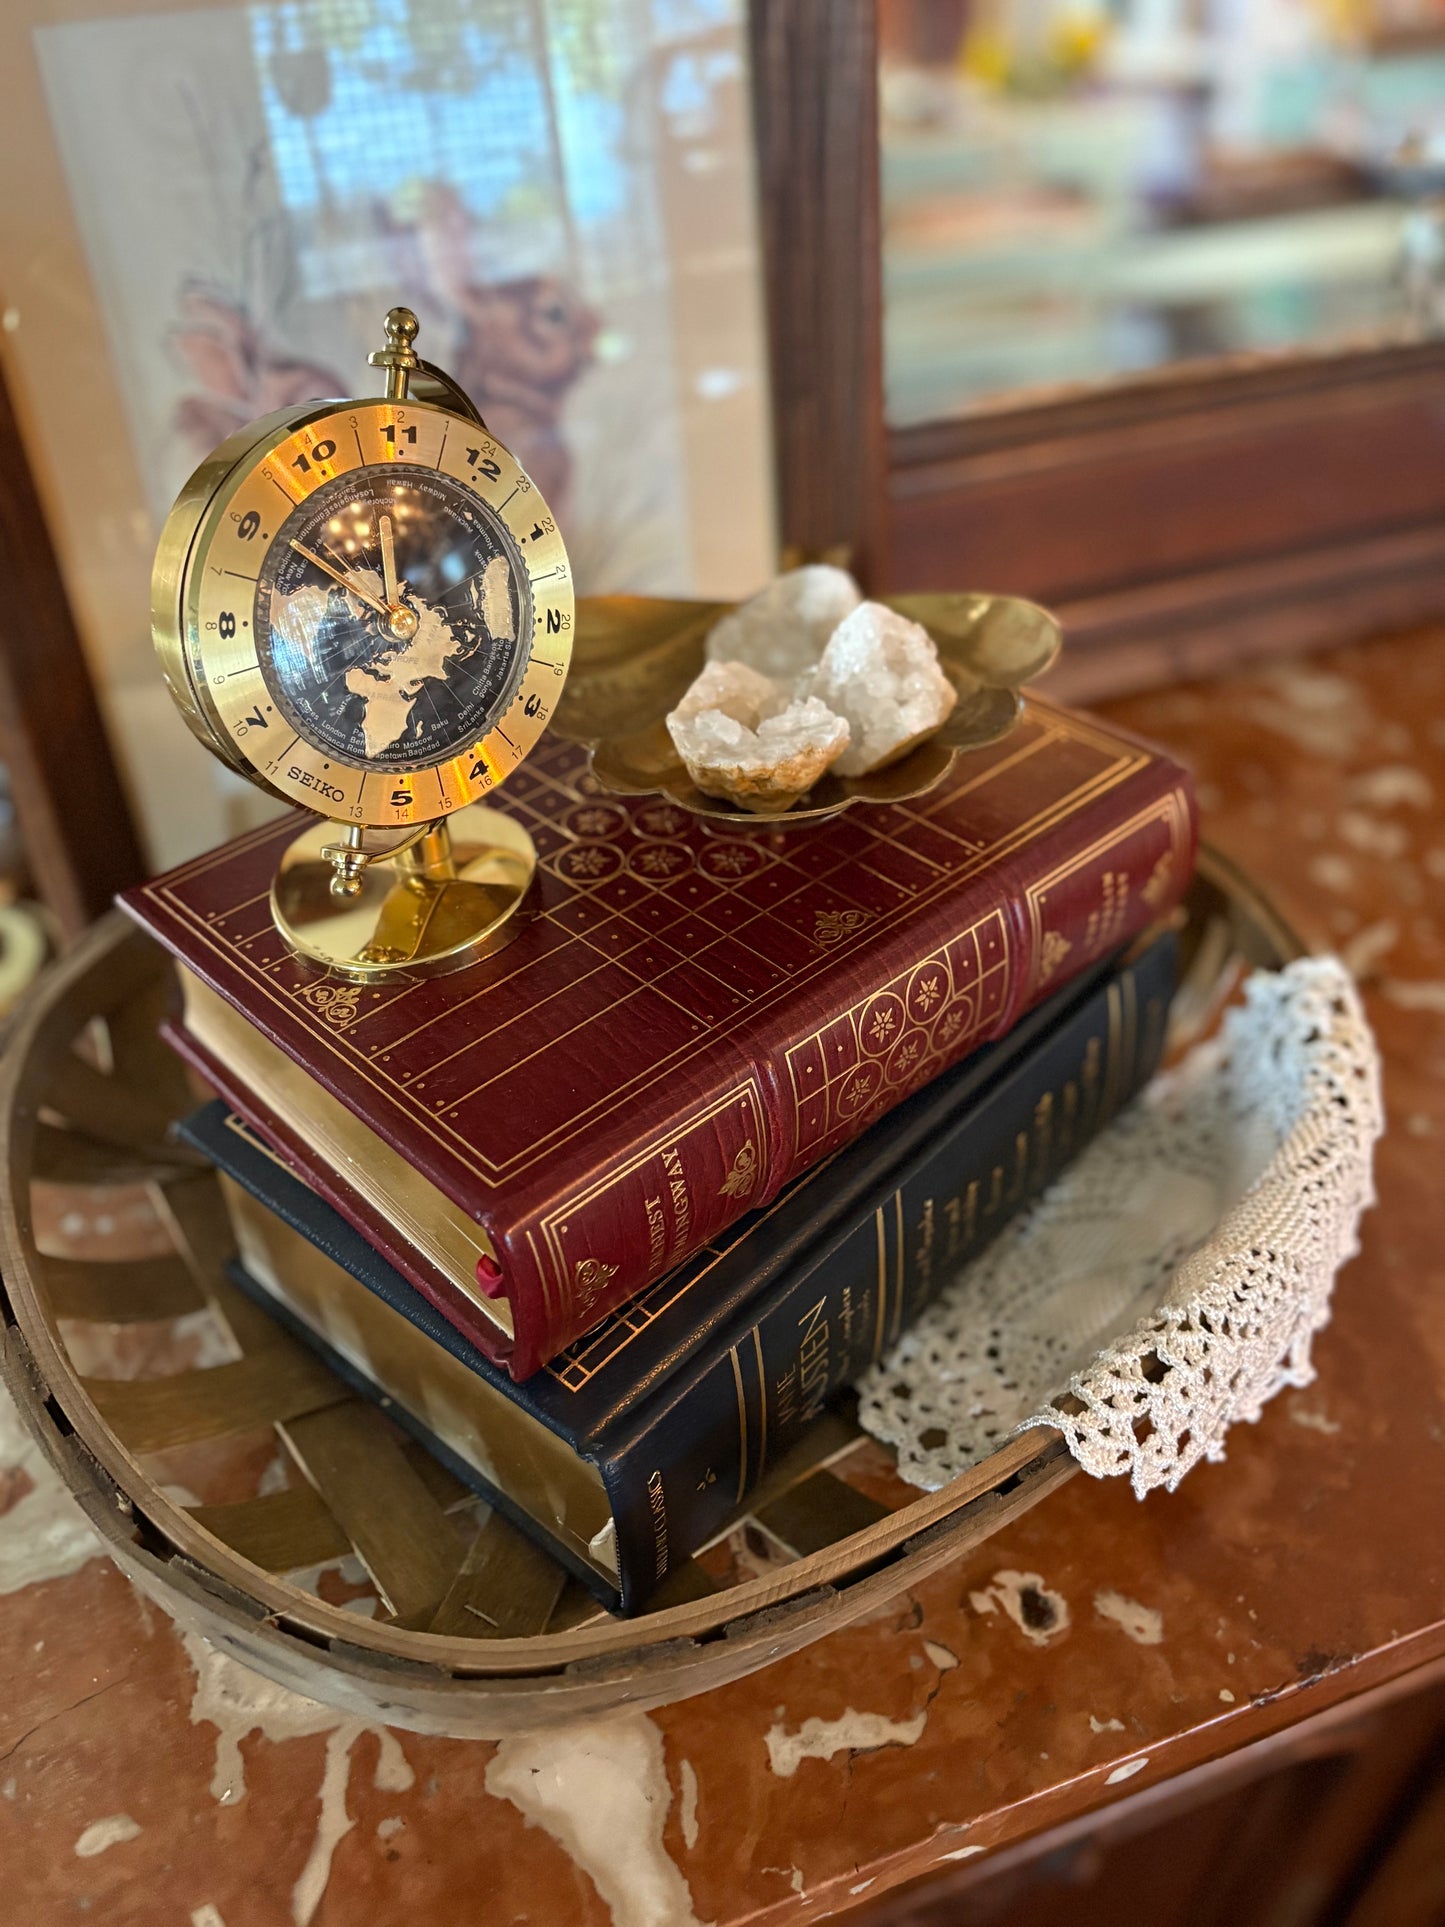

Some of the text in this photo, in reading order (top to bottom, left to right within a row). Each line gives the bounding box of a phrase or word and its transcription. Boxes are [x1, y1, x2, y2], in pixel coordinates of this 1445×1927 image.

[348, 415, 359, 429] 3
[397, 410, 405, 424] 2
[378, 424, 418, 444] 11
[444, 420, 450, 432] 1
[303, 433, 313, 445] 4
[291, 439, 337, 473] 10
[480, 440, 497, 458] 24
[465, 446, 502, 483] 12
[260, 467, 273, 480] 5
[386, 478, 413, 489] Hawaii
[515, 475, 531, 494] 23
[418, 483, 447, 502] Midway
[229, 511, 241, 523] 6
[237, 510, 261, 542] 9
[473, 519, 494, 549] Noumea
[529, 522, 545, 542] 1
[541, 516, 555, 536] 22
[210, 566, 223, 577] 7
[554, 564, 568, 580] 21
[205, 620, 218, 631] 8
[218, 610, 236, 640] 8
[546, 608, 561, 635] 2
[561, 614, 571, 631] 20
[553, 662, 565, 677] 19
[212, 675, 226, 685] 9
[457, 702, 475, 721] Delhi
[523, 693, 541, 718] 3
[537, 706, 549, 721] 18
[245, 705, 269, 729] 7
[430, 718, 450, 732] Baku
[232, 719, 249, 738] 10
[321, 720, 347, 740] London
[347, 744, 366, 757] Rom
[403, 734, 433, 750] Moscow
[408, 740, 441, 757] Baghdad
[511, 745, 524, 761] 17
[265, 760, 279, 776] 11
[468, 759, 490, 781] 4
[287, 766, 345, 803] SEIKO
[478, 775, 493, 790] 16
[390, 790, 413, 807] 5
[438, 799, 453, 811] 15
[349, 805, 363, 819] 13
[395, 808, 409, 821] 14
[661, 1147, 690, 1266] MINGWAY
[798, 1295, 829, 1422] USTEN
